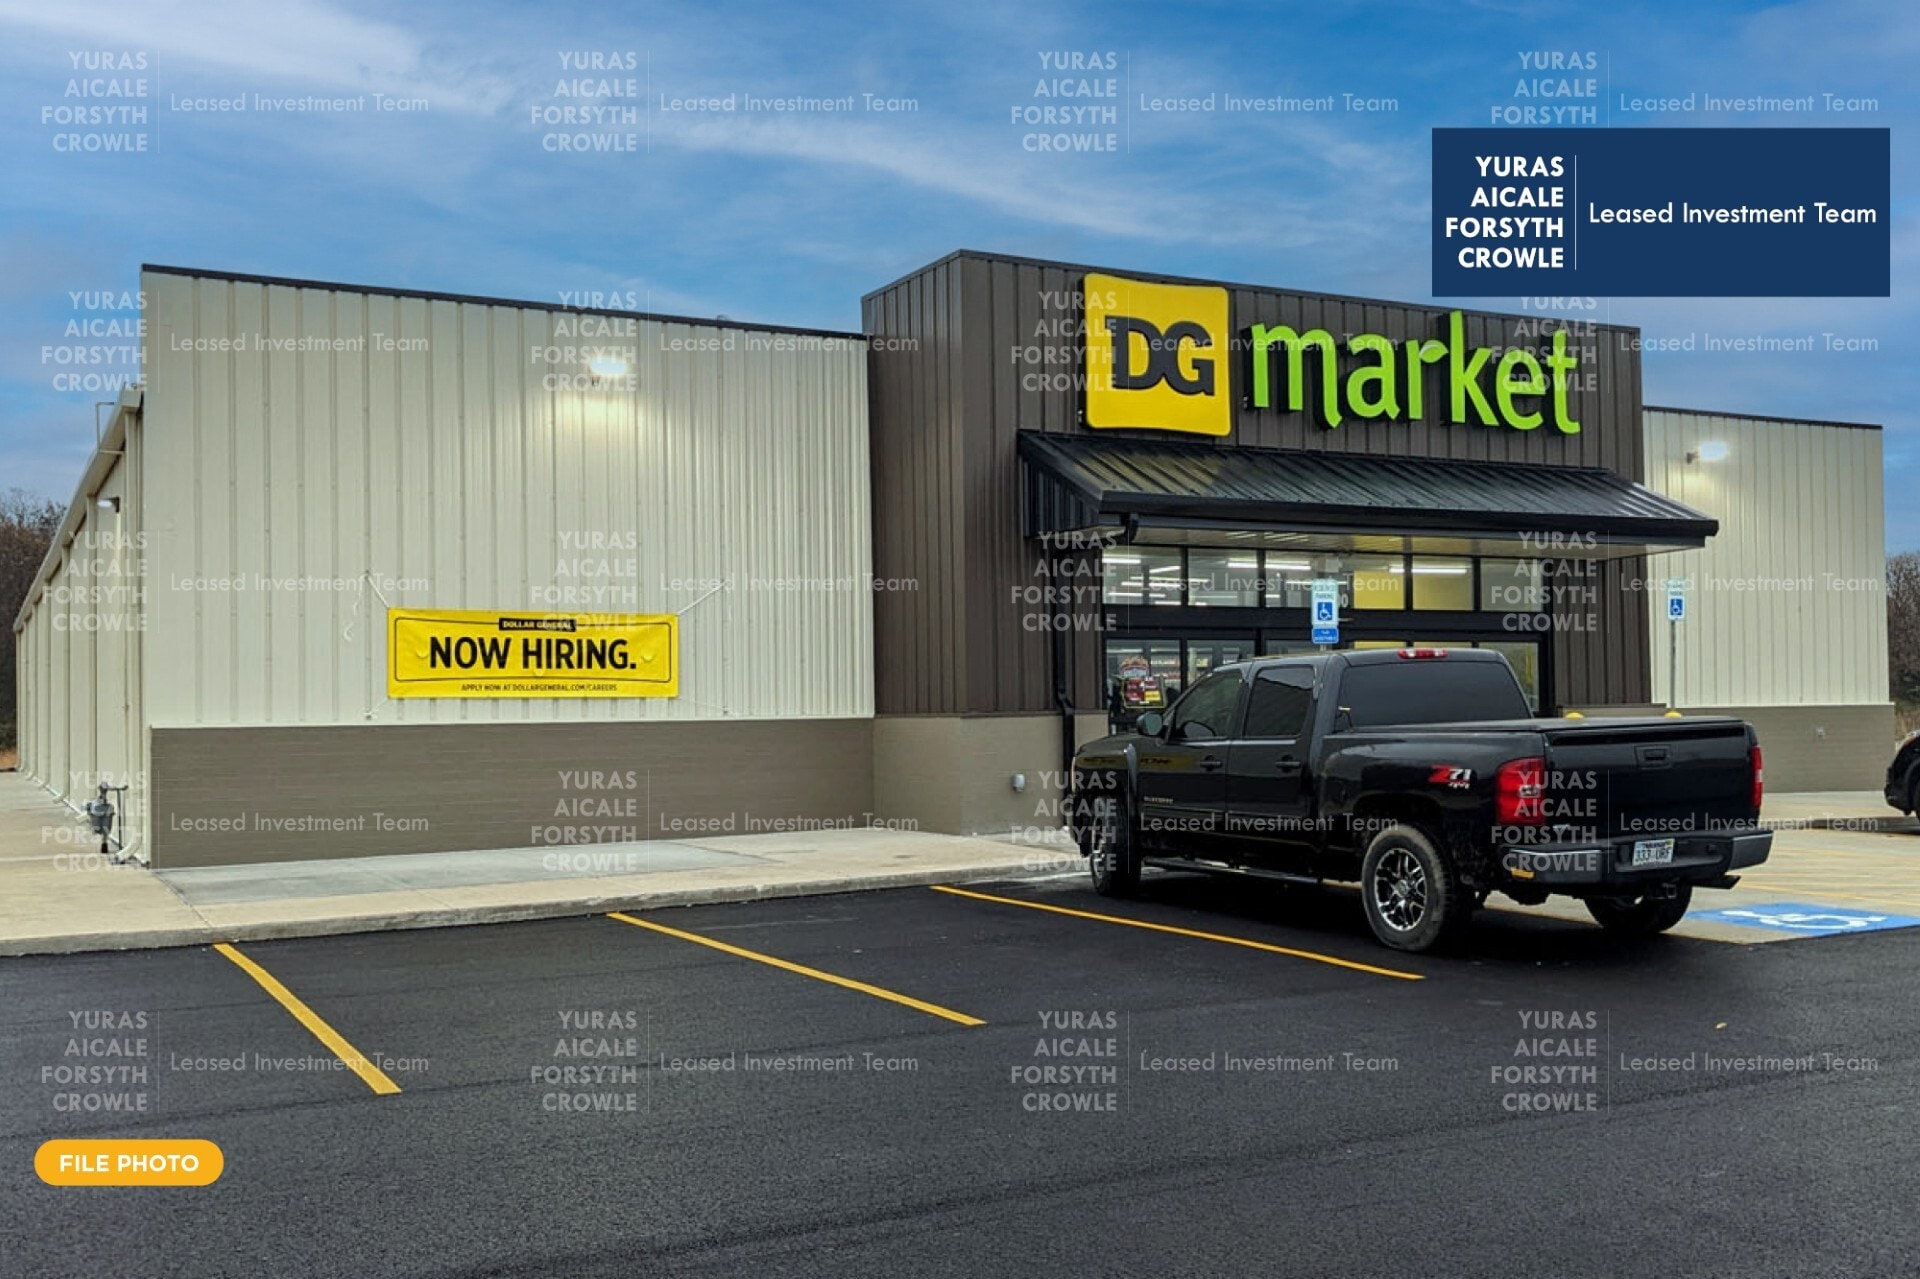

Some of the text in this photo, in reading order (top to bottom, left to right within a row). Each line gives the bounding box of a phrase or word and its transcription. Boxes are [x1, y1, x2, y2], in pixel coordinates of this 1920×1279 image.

[1105, 311, 1581, 434] DG market
[503, 620, 535, 629] DOLLAR
[430, 637, 637, 670] NOW HIRING.
